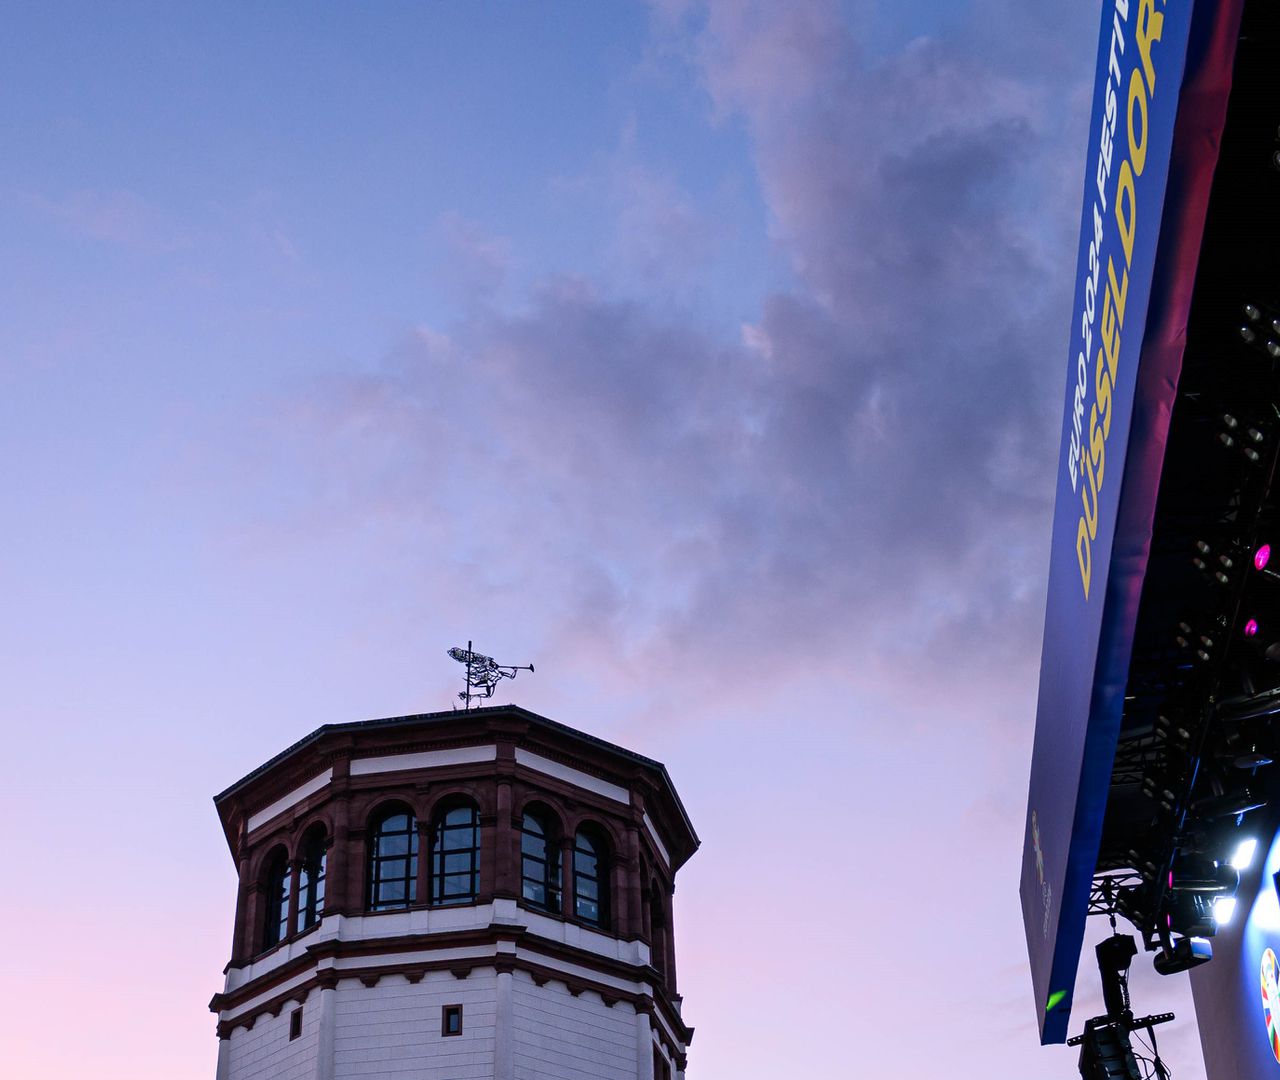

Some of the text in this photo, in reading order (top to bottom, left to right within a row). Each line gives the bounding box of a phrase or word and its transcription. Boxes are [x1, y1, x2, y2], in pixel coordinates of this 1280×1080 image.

[1068, 351, 1087, 494] EURO
[1082, 201, 1104, 363] 2024
[1076, 0, 1167, 602] DÜSSELDOR
